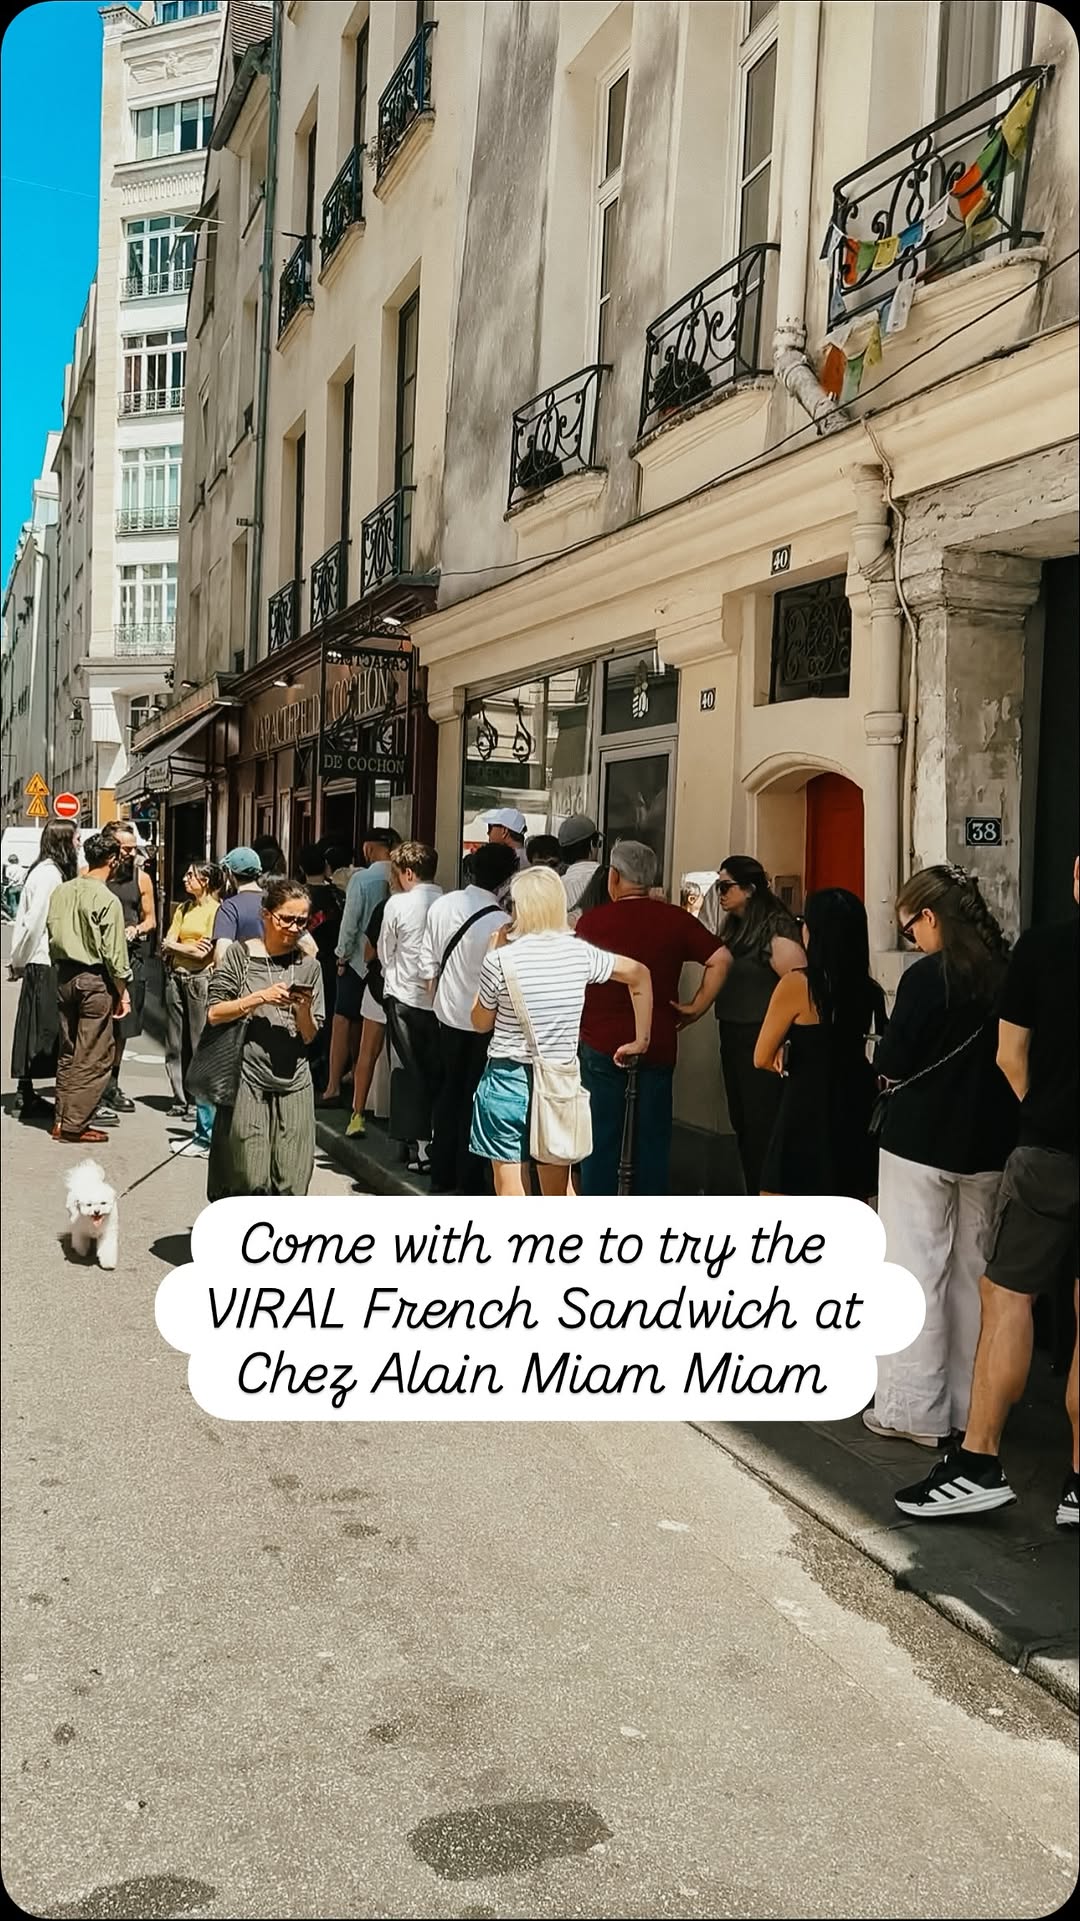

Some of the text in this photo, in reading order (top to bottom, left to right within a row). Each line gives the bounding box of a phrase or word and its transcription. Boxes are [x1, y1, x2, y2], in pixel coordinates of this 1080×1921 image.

[773, 549, 788, 570] 40
[702, 691, 714, 709] 40
[323, 754, 405, 774] DE COCHON
[972, 822, 997, 841] 38
